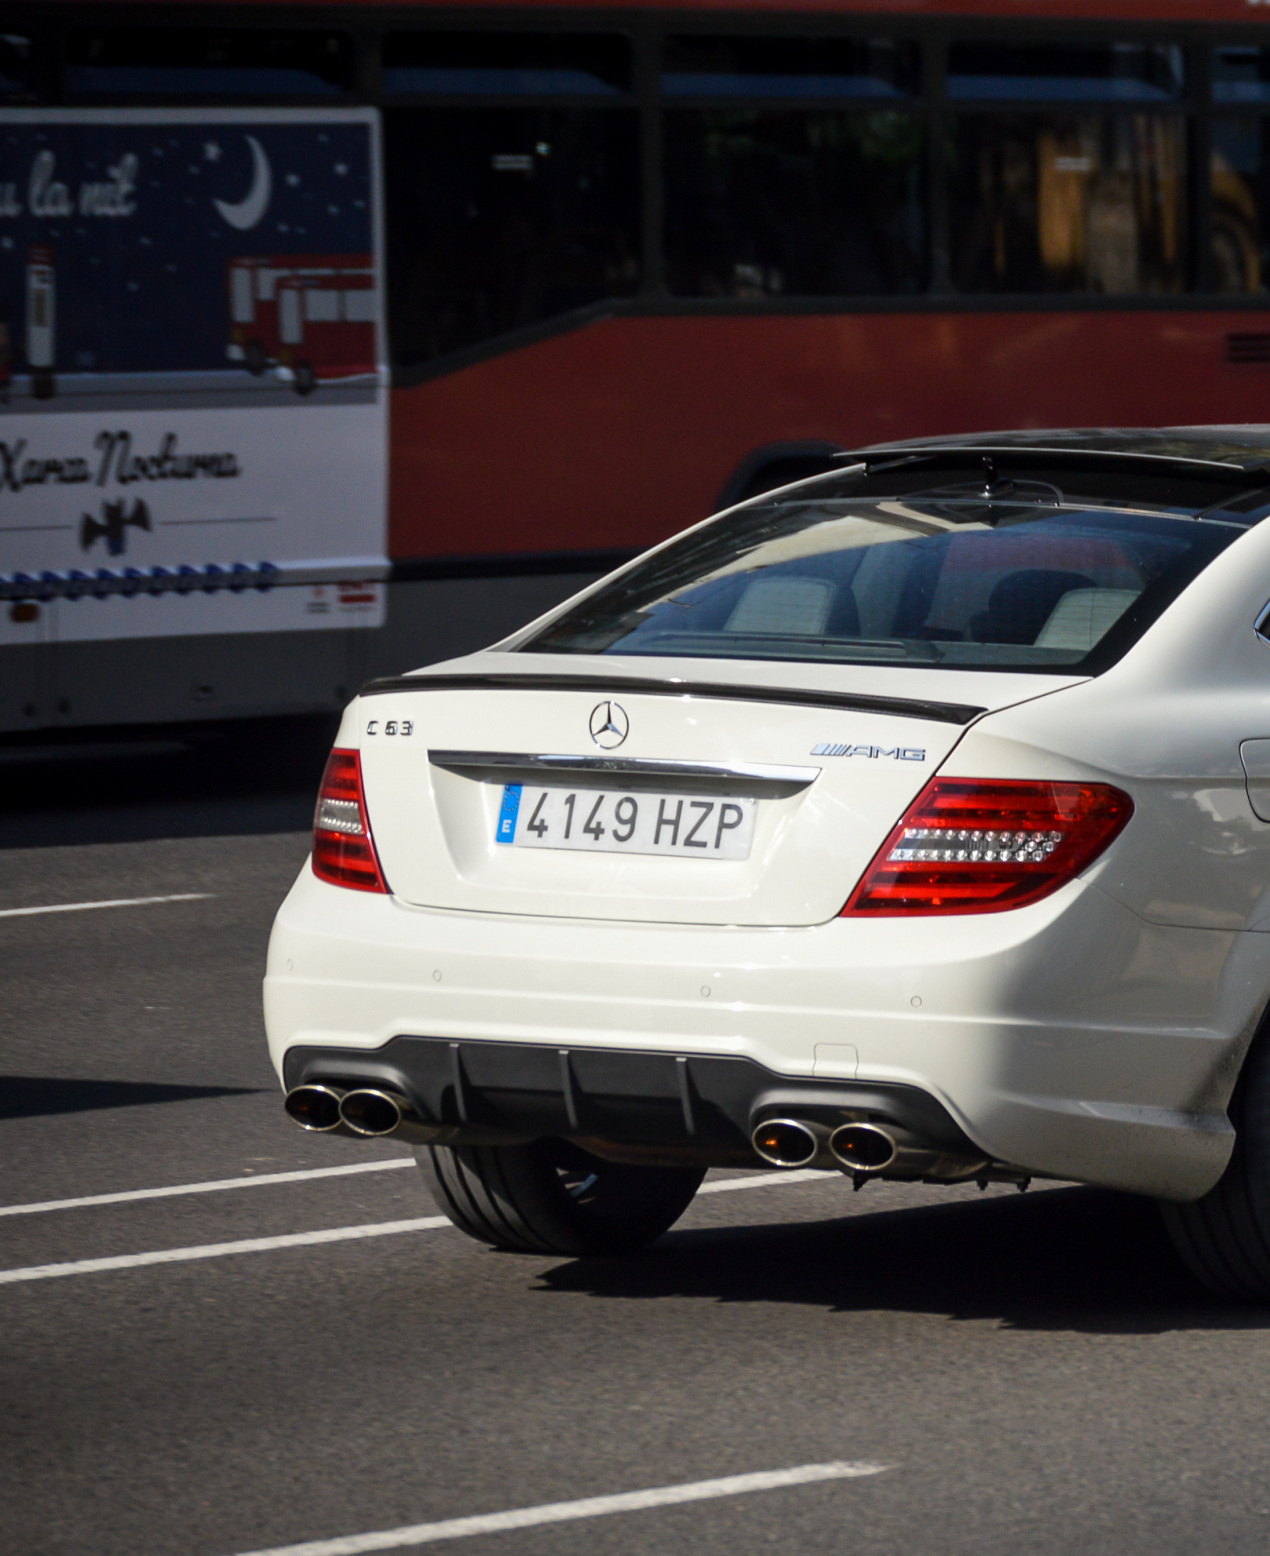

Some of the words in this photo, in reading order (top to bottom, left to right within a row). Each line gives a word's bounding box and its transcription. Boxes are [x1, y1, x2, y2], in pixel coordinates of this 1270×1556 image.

[367, 720, 379, 736] C
[385, 720, 413, 736] 63
[845, 743, 926, 762] AMG
[501, 819, 512, 833] E
[526, 792, 639, 843] 4149
[653, 798, 744, 850] HZP
